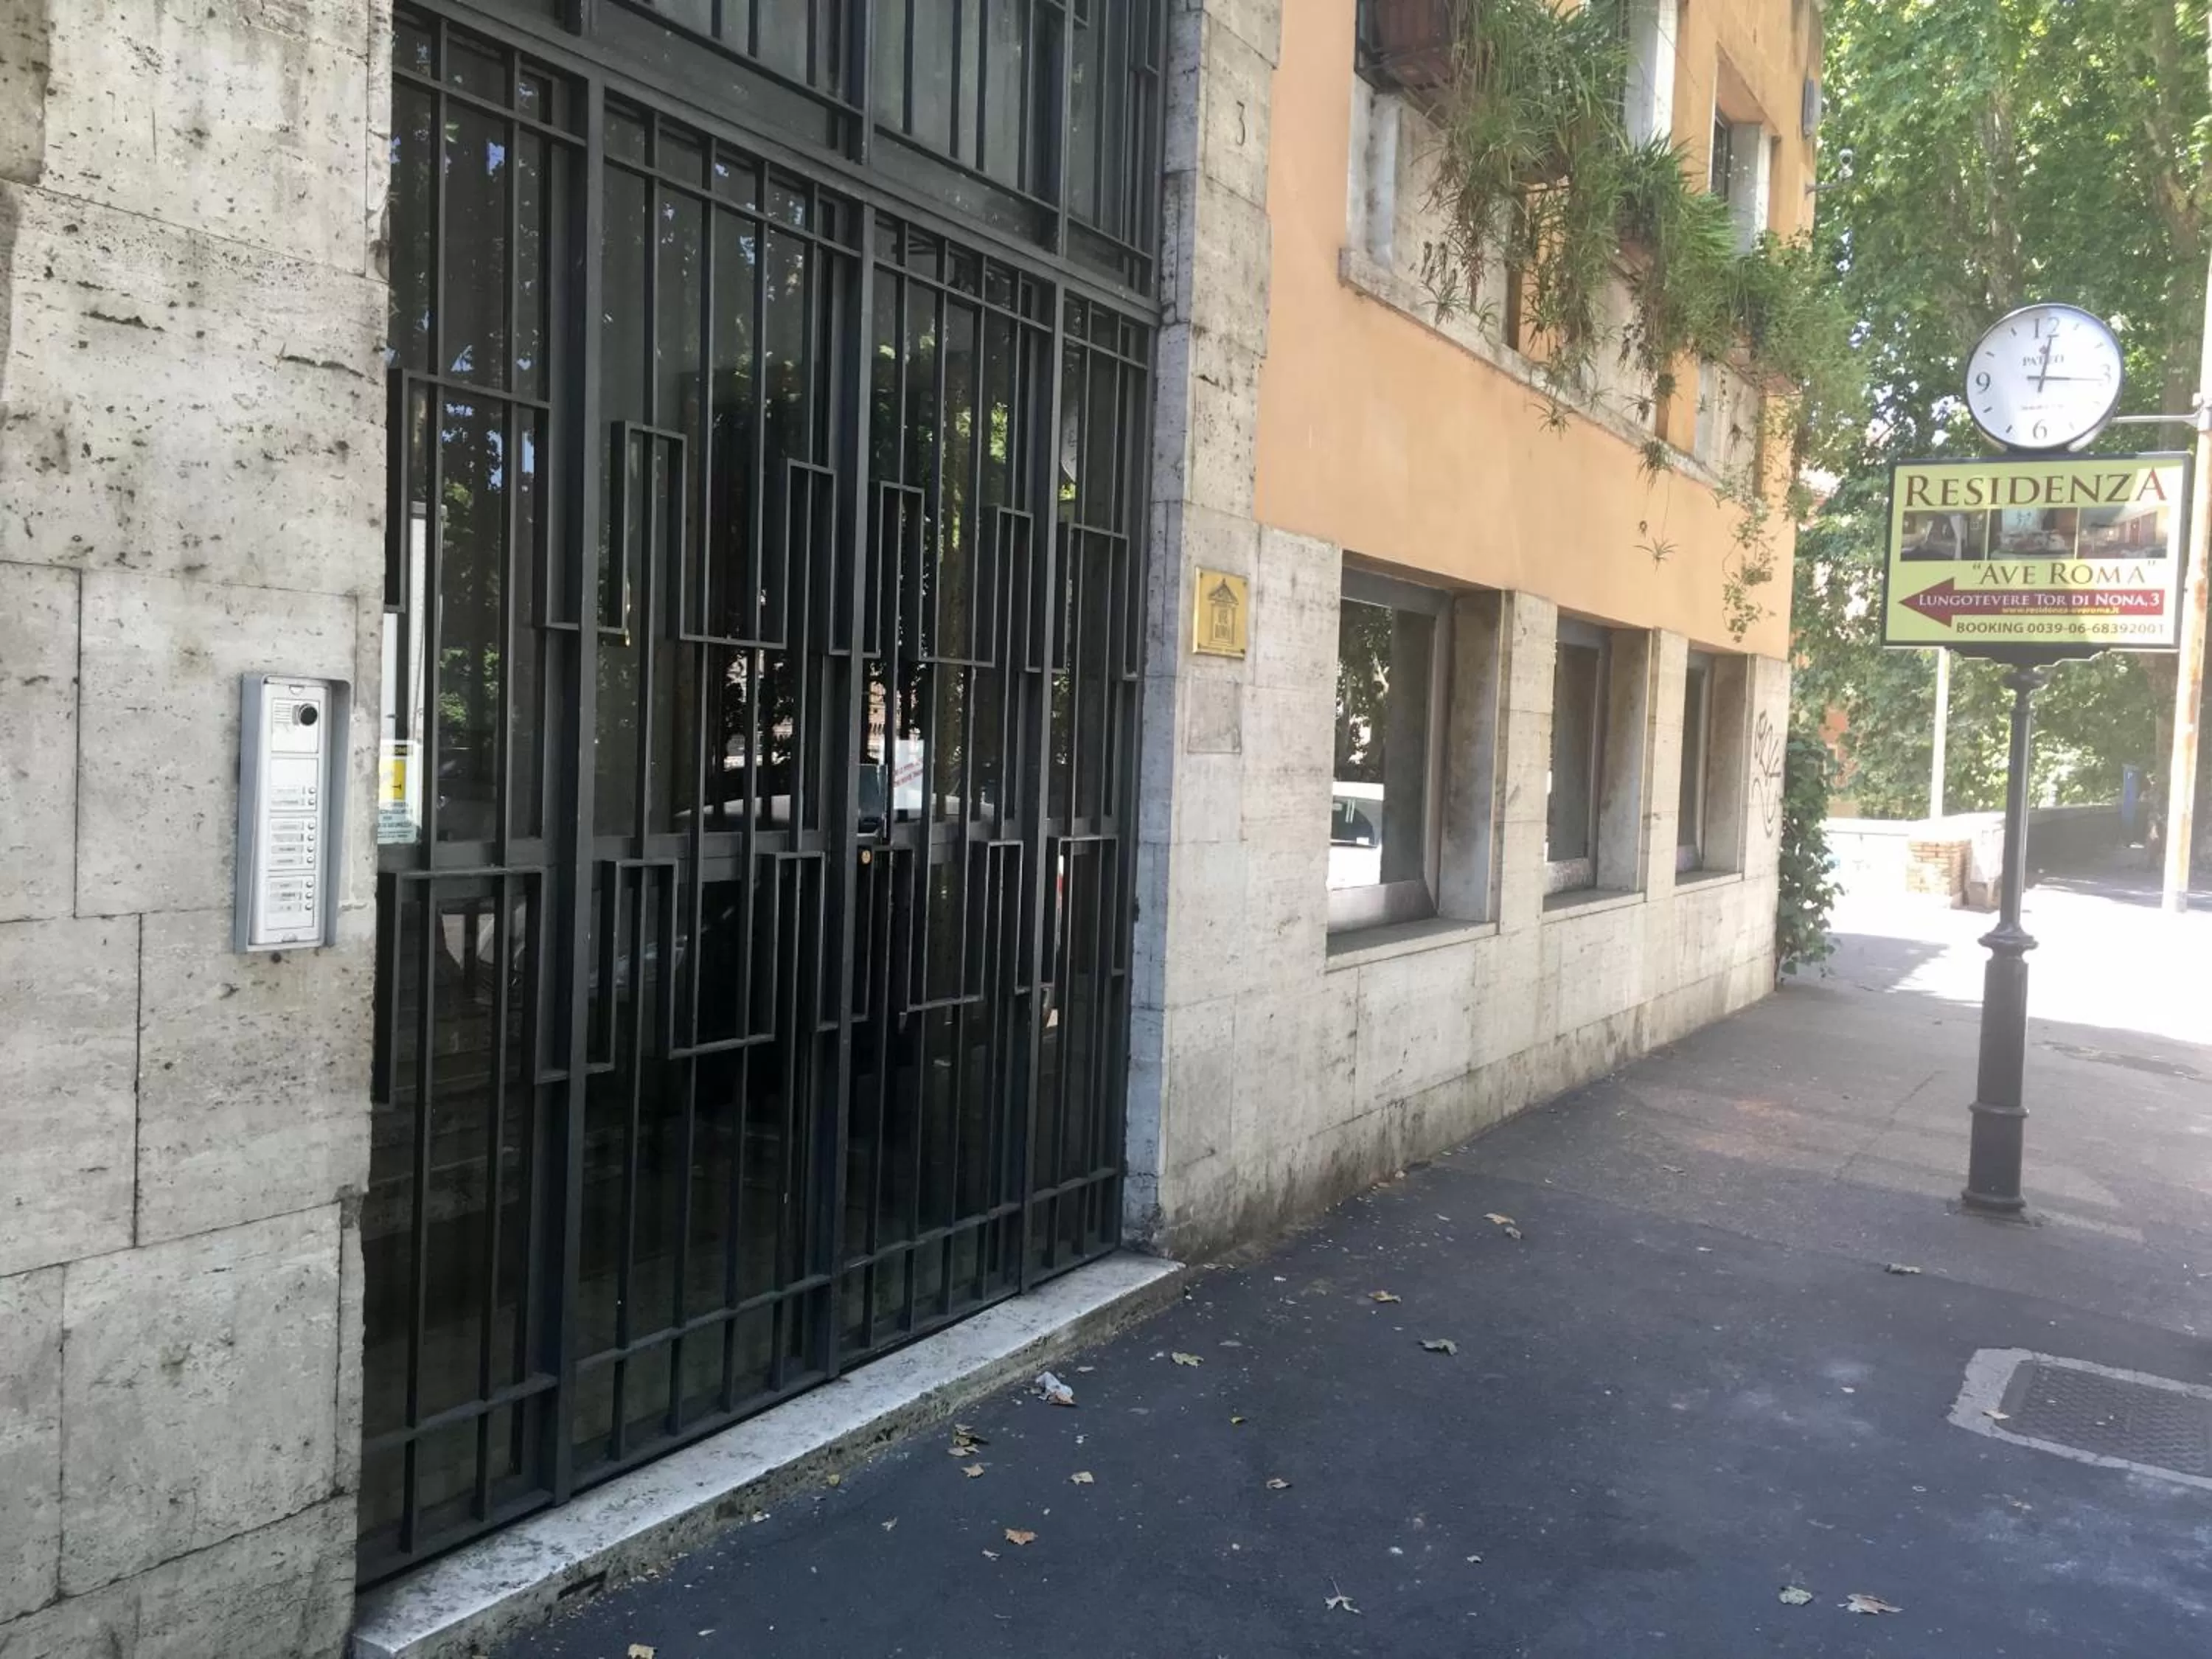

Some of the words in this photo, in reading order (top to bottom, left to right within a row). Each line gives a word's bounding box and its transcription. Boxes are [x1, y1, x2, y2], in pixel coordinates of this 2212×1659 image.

[2034, 317, 2059, 339] 12
[1975, 372, 1991, 394] 9
[2100, 364, 2112, 387] 3
[2033, 419, 2048, 440] 6
[1905, 466, 2168, 507] RESIDENZA
[1919, 594, 2030, 606] LUNGOTEVERE
[2150, 592, 2160, 605] 3
[1955, 622, 2024, 634] BOOKING
